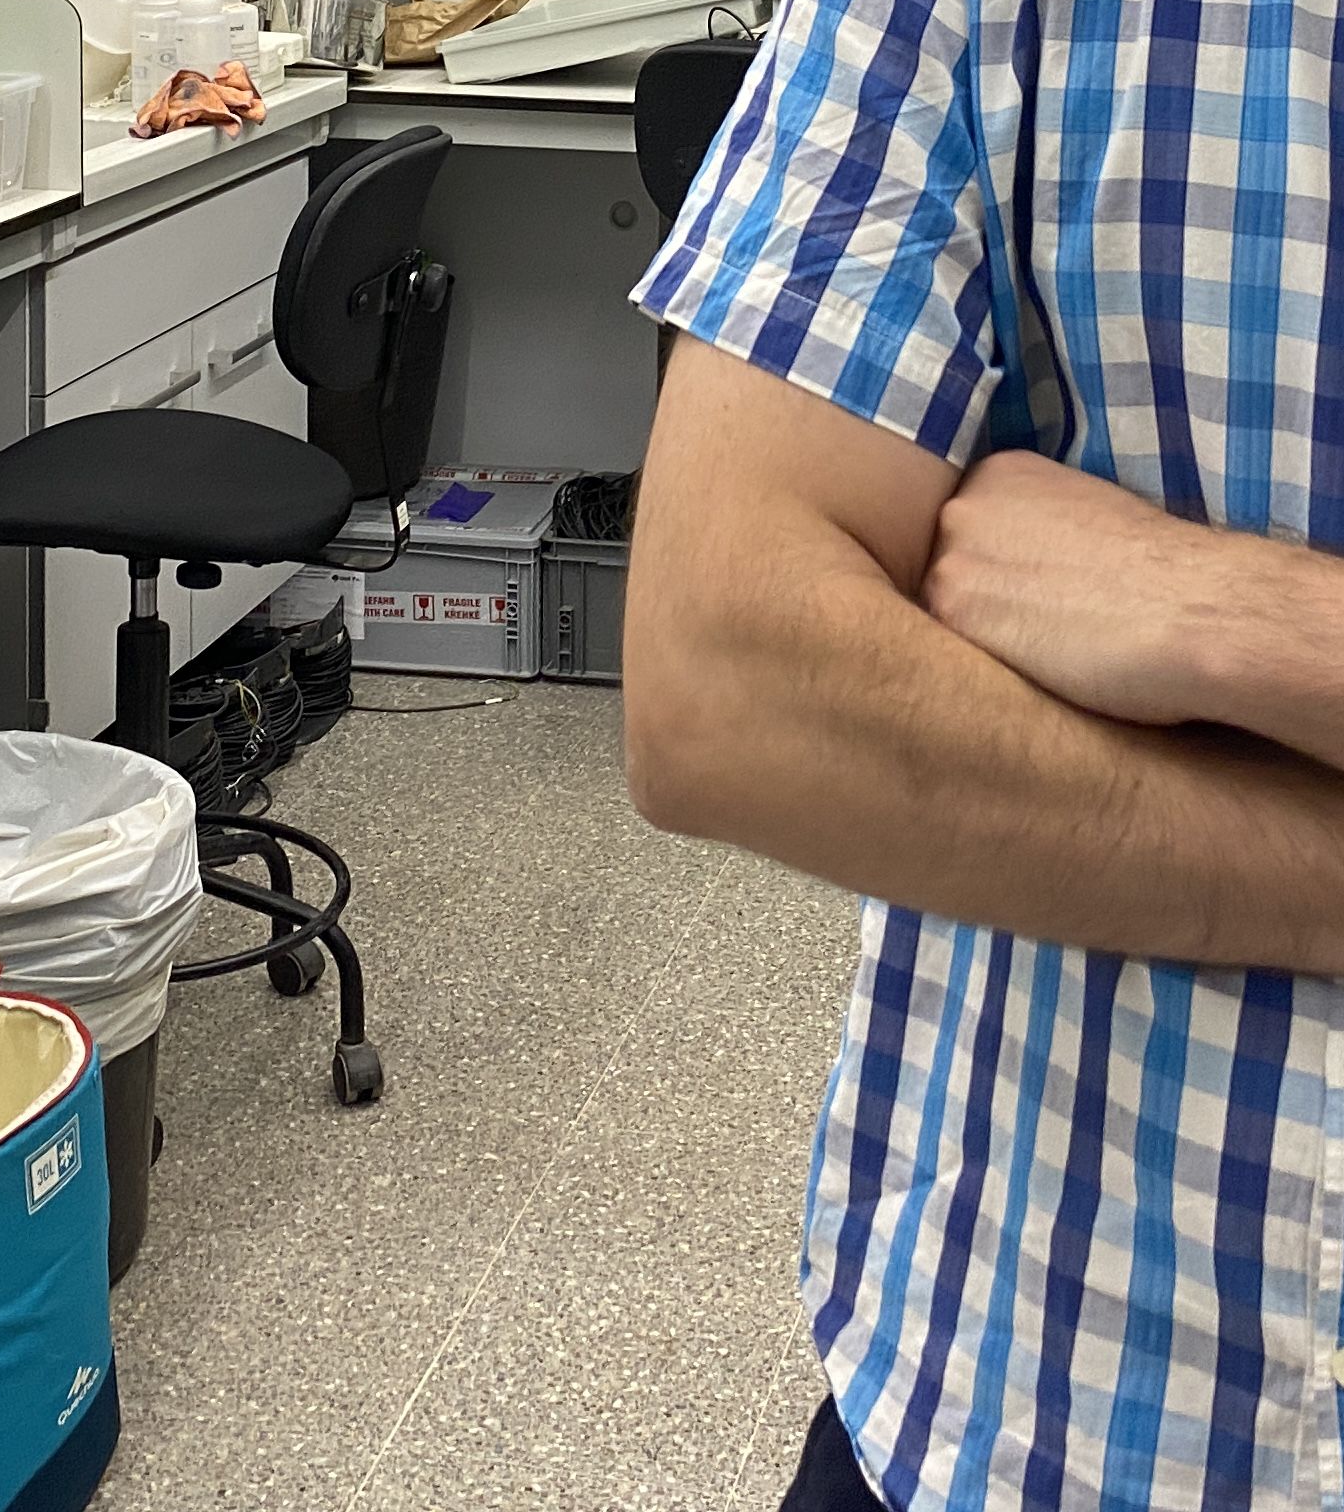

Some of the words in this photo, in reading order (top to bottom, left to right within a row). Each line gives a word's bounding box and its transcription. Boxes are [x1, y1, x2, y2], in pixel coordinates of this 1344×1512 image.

[364, 596, 395, 605] EFAHR
[443, 597, 482, 608] FRAGILE
[383, 608, 405, 618] CARE
[36, 1160, 55, 1186] 30L
